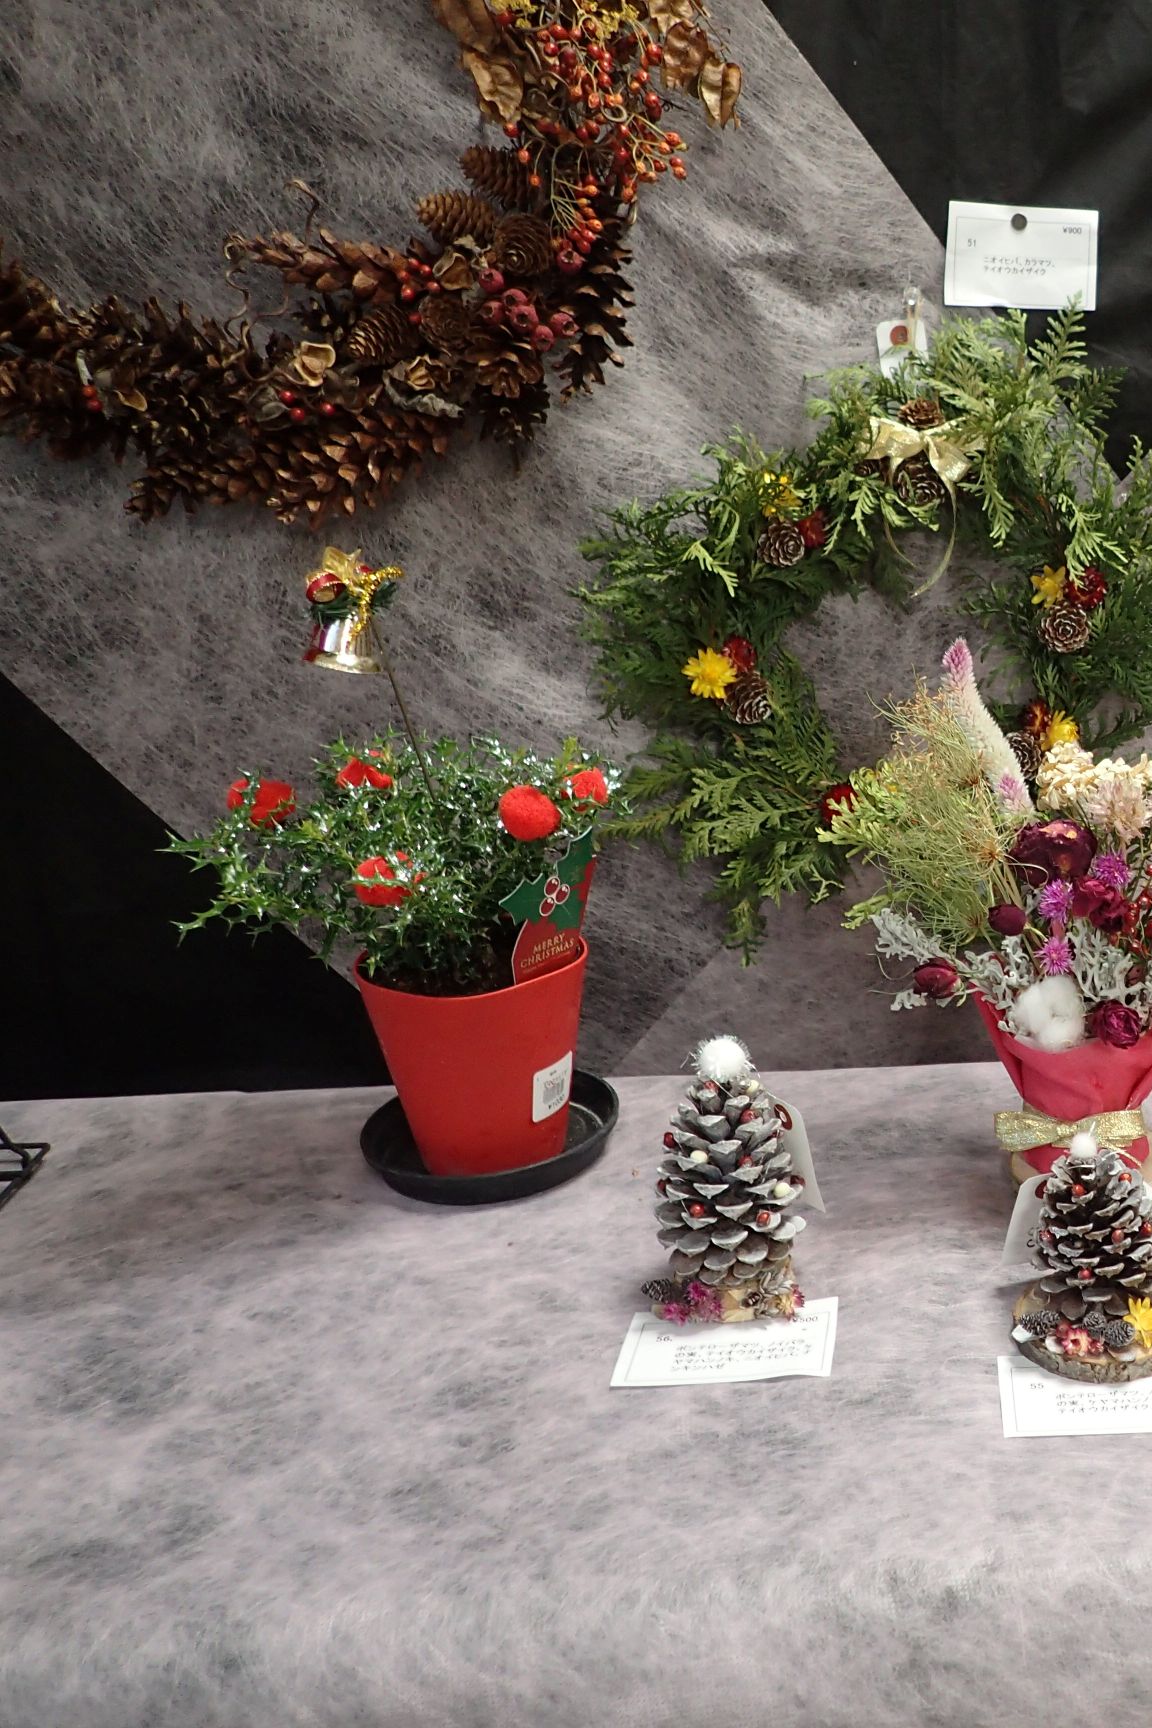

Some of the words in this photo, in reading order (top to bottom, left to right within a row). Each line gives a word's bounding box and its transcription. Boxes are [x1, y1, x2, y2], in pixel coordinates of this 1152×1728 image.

[1062, 226, 1082, 234] ¥900
[967, 238, 977, 247] 51
[533, 933, 566, 954] MERRY
[520, 938, 575, 968] CHRISTMAS
[1029, 1382, 1045, 1390] 55
